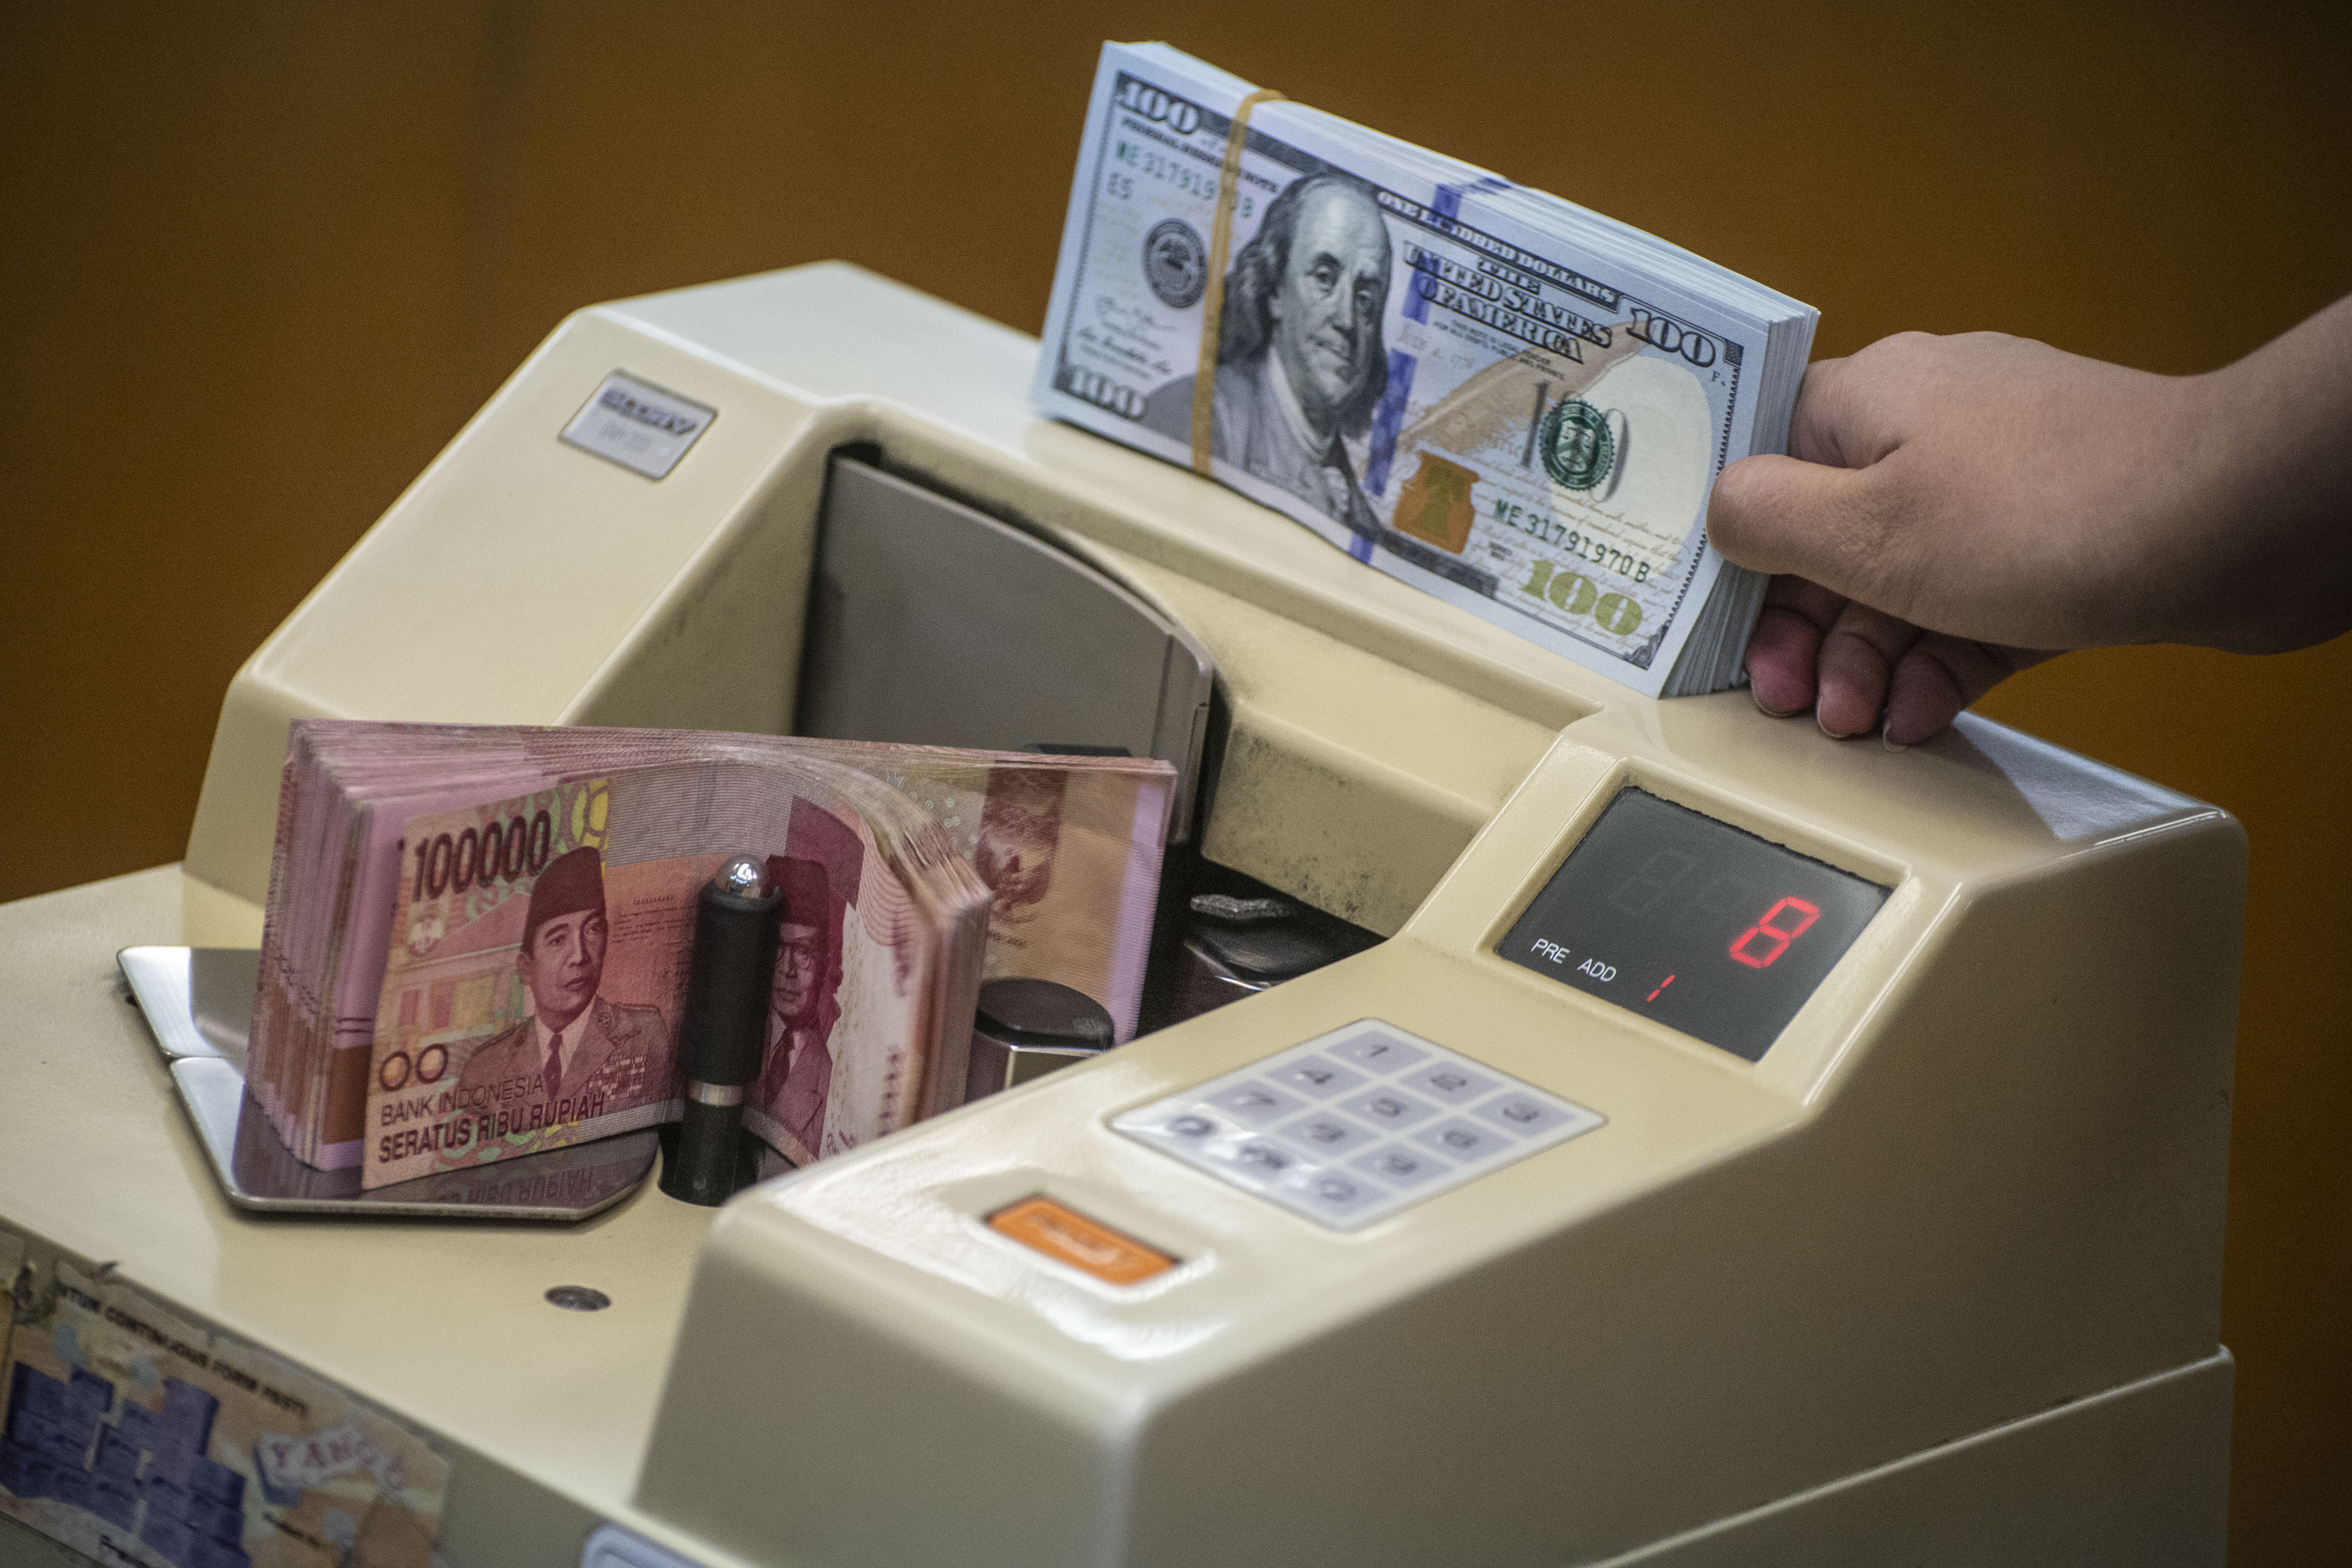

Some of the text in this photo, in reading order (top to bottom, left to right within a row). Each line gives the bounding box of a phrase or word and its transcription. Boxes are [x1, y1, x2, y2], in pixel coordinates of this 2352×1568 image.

[1118, 82, 1199, 135] 100
[1403, 239, 1612, 349] UNITED STATES
[1518, 253, 1615, 303] DOLLARS
[1451, 292, 1583, 365] AMERICA
[1626, 308, 1716, 368] 100
[1520, 559, 1643, 636] 100
[413, 809, 551, 902] 100000
[1532, 938, 1617, 983] PRE ADD
[1729, 895, 1820, 969] 8
[1646, 974, 1675, 1002] 1
[379, 1092, 605, 1164] SERATUS RIBU RUPIAH
[381, 1073, 544, 1126] BANK INDONESIA
